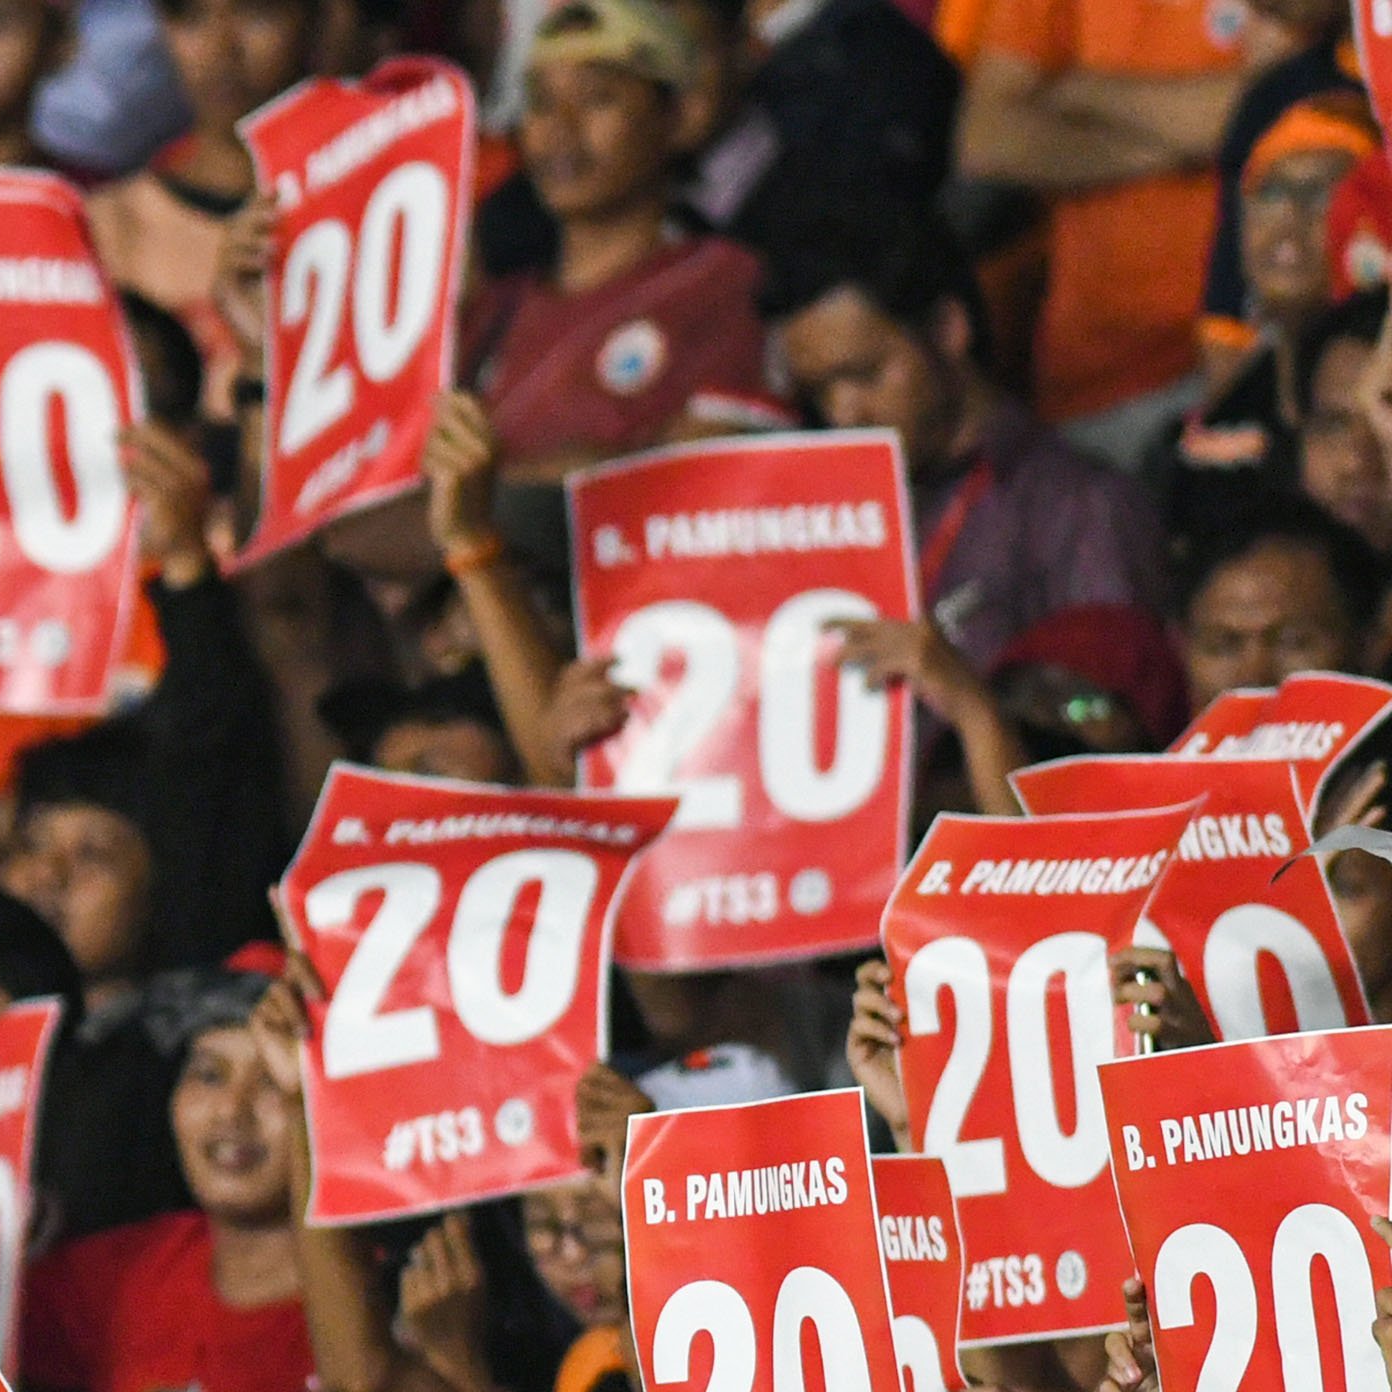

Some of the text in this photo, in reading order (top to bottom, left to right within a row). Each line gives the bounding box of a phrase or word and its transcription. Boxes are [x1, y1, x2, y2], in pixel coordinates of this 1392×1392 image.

[281, 160, 448, 457] 20
[607, 587, 890, 831] 20
[916, 845, 1169, 897] B. PAMUNGKAS
[305, 847, 601, 1080] 20
[904, 930, 1114, 1199] 20
[383, 1105, 486, 1171] #TS3
[1122, 1092, 1369, 1173] B. PAMUNGKAS
[643, 1156, 849, 1226] B. PAMUNGKAS
[966, 1253, 1045, 1310] #TS3
